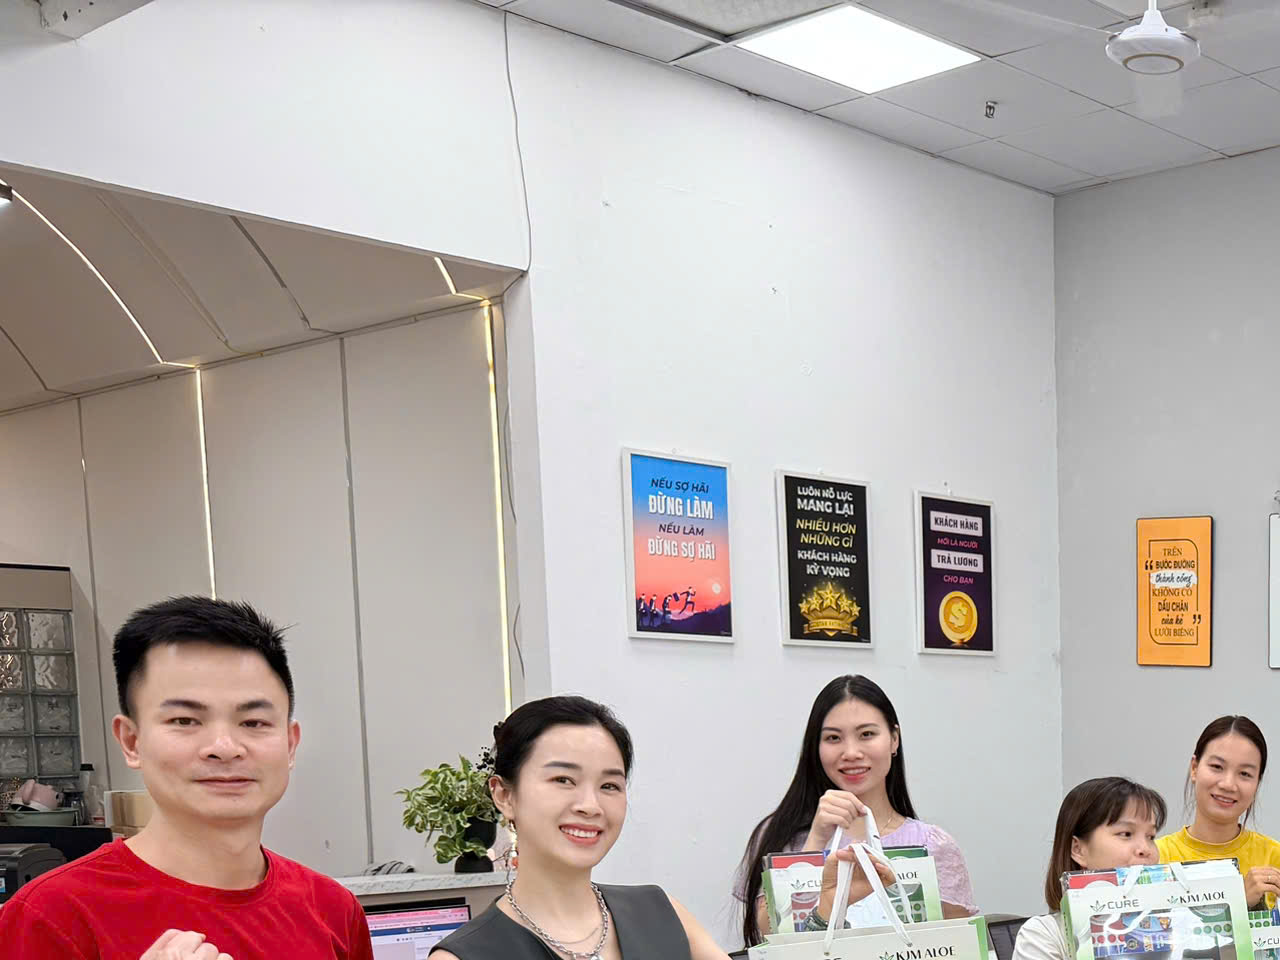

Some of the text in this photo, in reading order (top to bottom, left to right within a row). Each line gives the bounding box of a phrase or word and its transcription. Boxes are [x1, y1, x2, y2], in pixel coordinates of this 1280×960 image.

[651, 477, 709, 494] NẾU SỢ HÃI
[797, 486, 853, 501] LUÔN NỖ LỰC
[648, 490, 714, 520] ĐỪNG LÀM
[797, 498, 854, 518] MANG LẠI
[658, 522, 704, 537] NẾU LÀM
[796, 518, 857, 535] NHIỀU HƠN
[934, 515, 979, 531] KHÁCH HÀNG
[800, 533, 853, 548] NHỮNG GÌ
[647, 535, 716, 562] ĐỪNG SỢ HÃI
[1162, 546, 1183, 556] TRÊN
[797, 550, 857, 564] KHÁCH HÀNG
[936, 552, 951, 565] TRẢ
[806, 562, 850, 579] KỲ VỌNG
[943, 575, 958, 583] CHO
[1152, 587, 1180, 597] KHÔNG
[1106, 898, 1140, 911] CURE
[924, 945, 957, 959] ALOE
